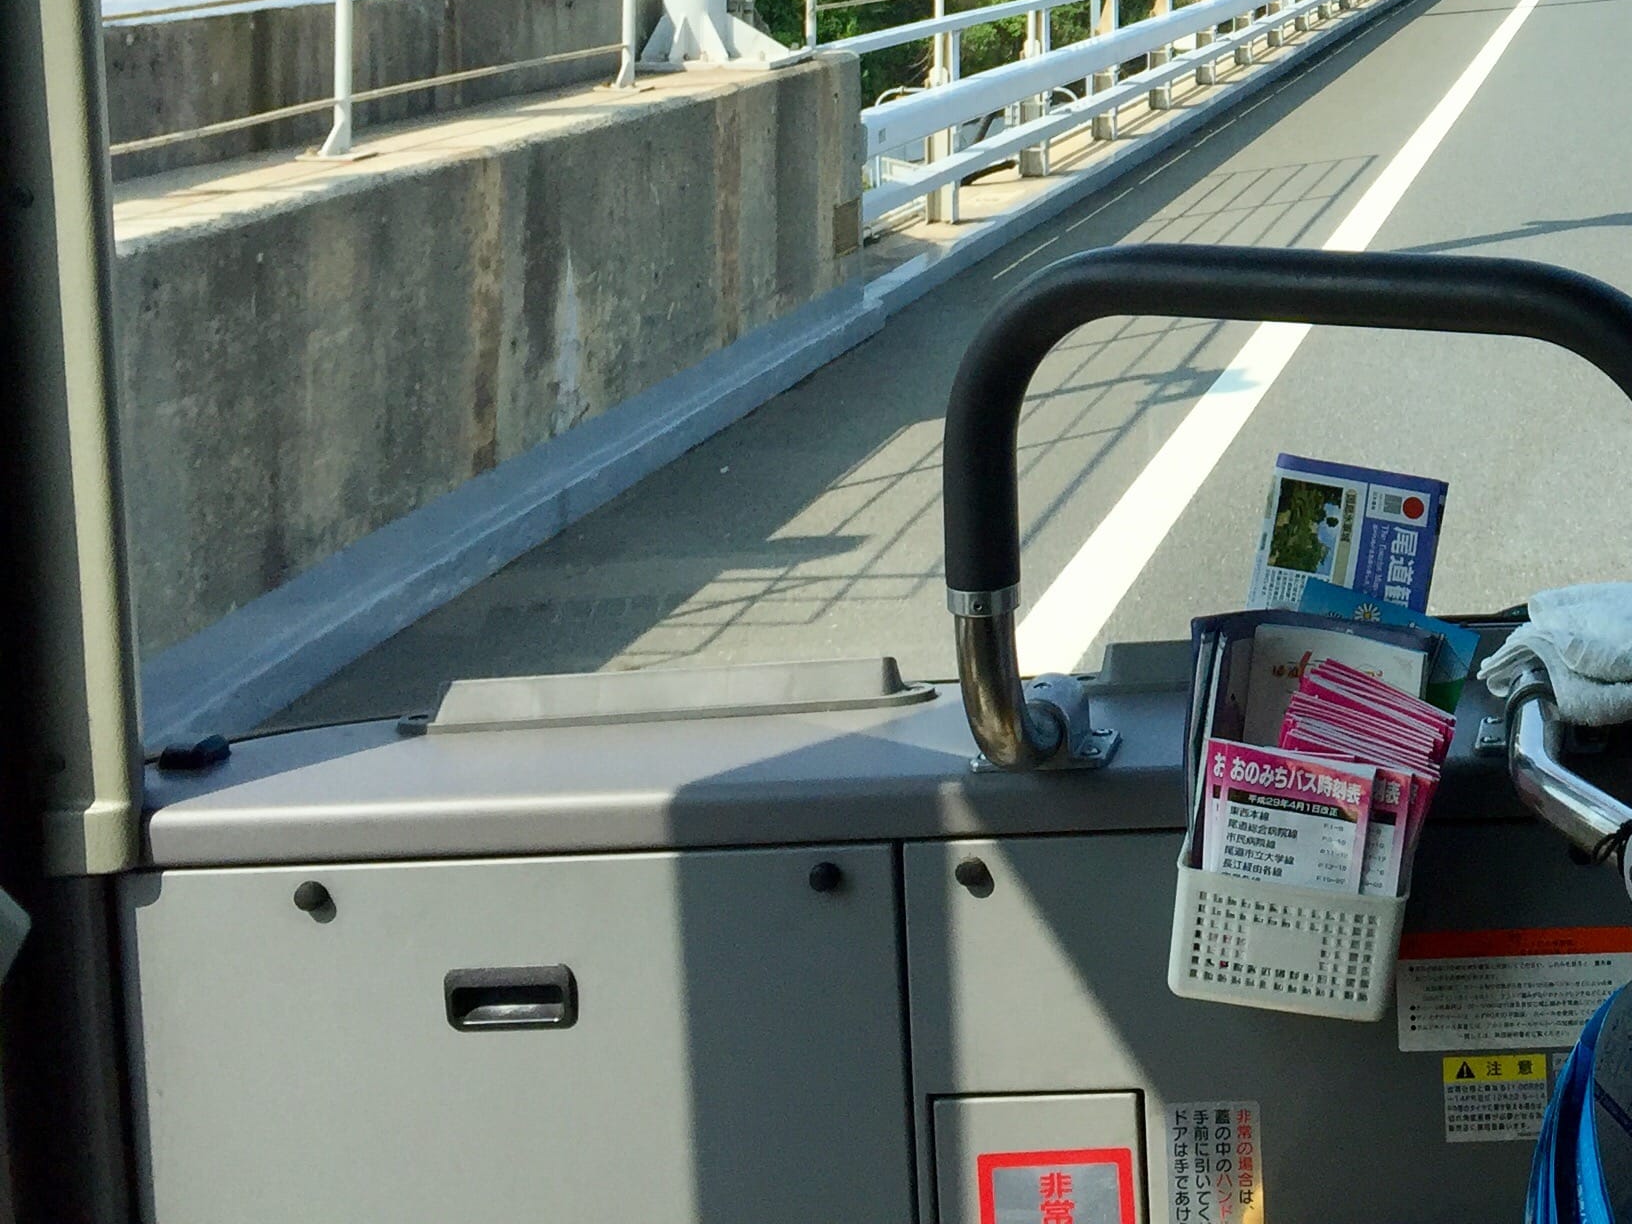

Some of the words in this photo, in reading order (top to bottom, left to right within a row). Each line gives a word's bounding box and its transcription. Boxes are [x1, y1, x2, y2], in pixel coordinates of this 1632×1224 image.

[1229, 757, 1362, 805] おのみちバス時刻表
[1248, 794, 1339, 816] 平成29年4月1日改正
[1230, 806, 1270, 822] 東西本線
[1224, 846, 1295, 865] 尾道市立大学線
[1226, 833, 1277, 849] 市民病院線
[1173, 1110, 1191, 1224] ドアは手であけ
[1193, 1110, 1212, 1224] 手前に引いてく
[1214, 1109, 1233, 1224] 蓋の中のハンド
[1236, 1108, 1255, 1210] 非常の場合は、
